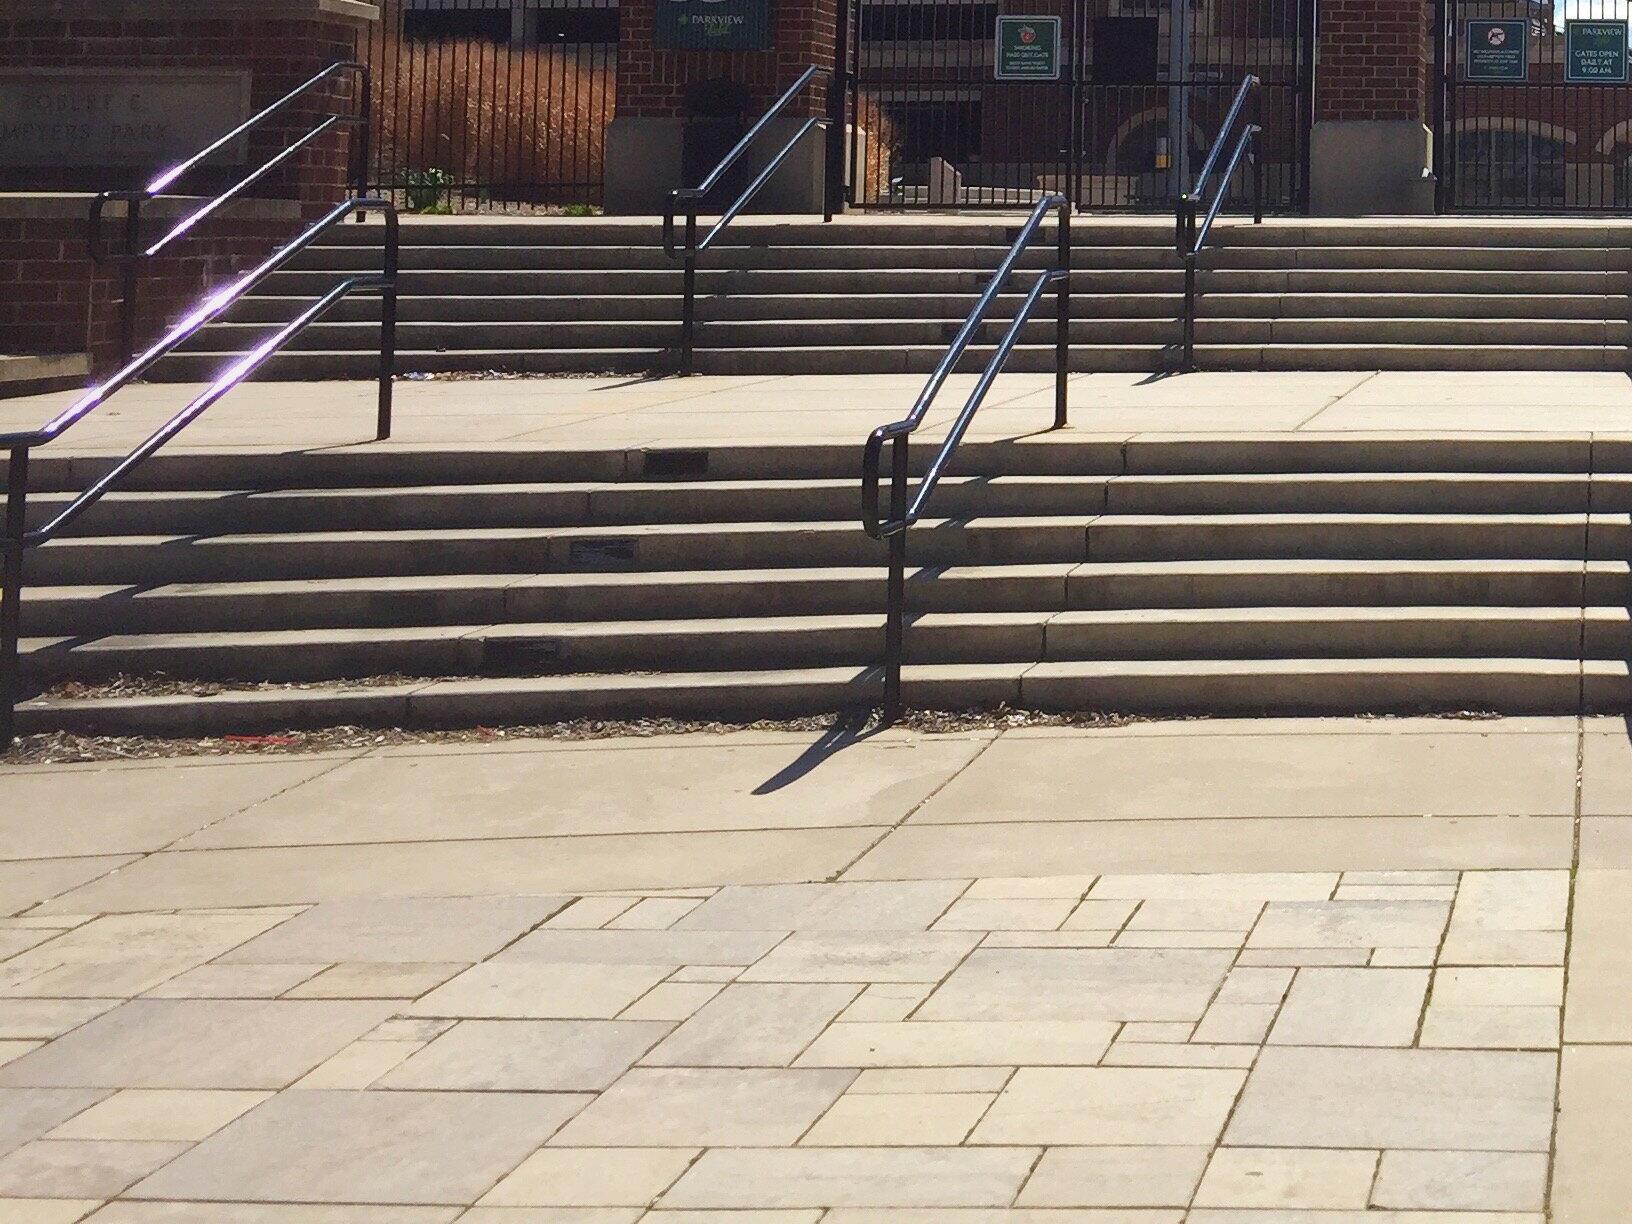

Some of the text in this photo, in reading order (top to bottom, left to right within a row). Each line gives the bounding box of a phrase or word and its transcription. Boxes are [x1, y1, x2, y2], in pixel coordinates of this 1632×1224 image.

[692, 15, 744, 25] PARKVIEW
[1575, 50, 1619, 58] GATES OPEN
